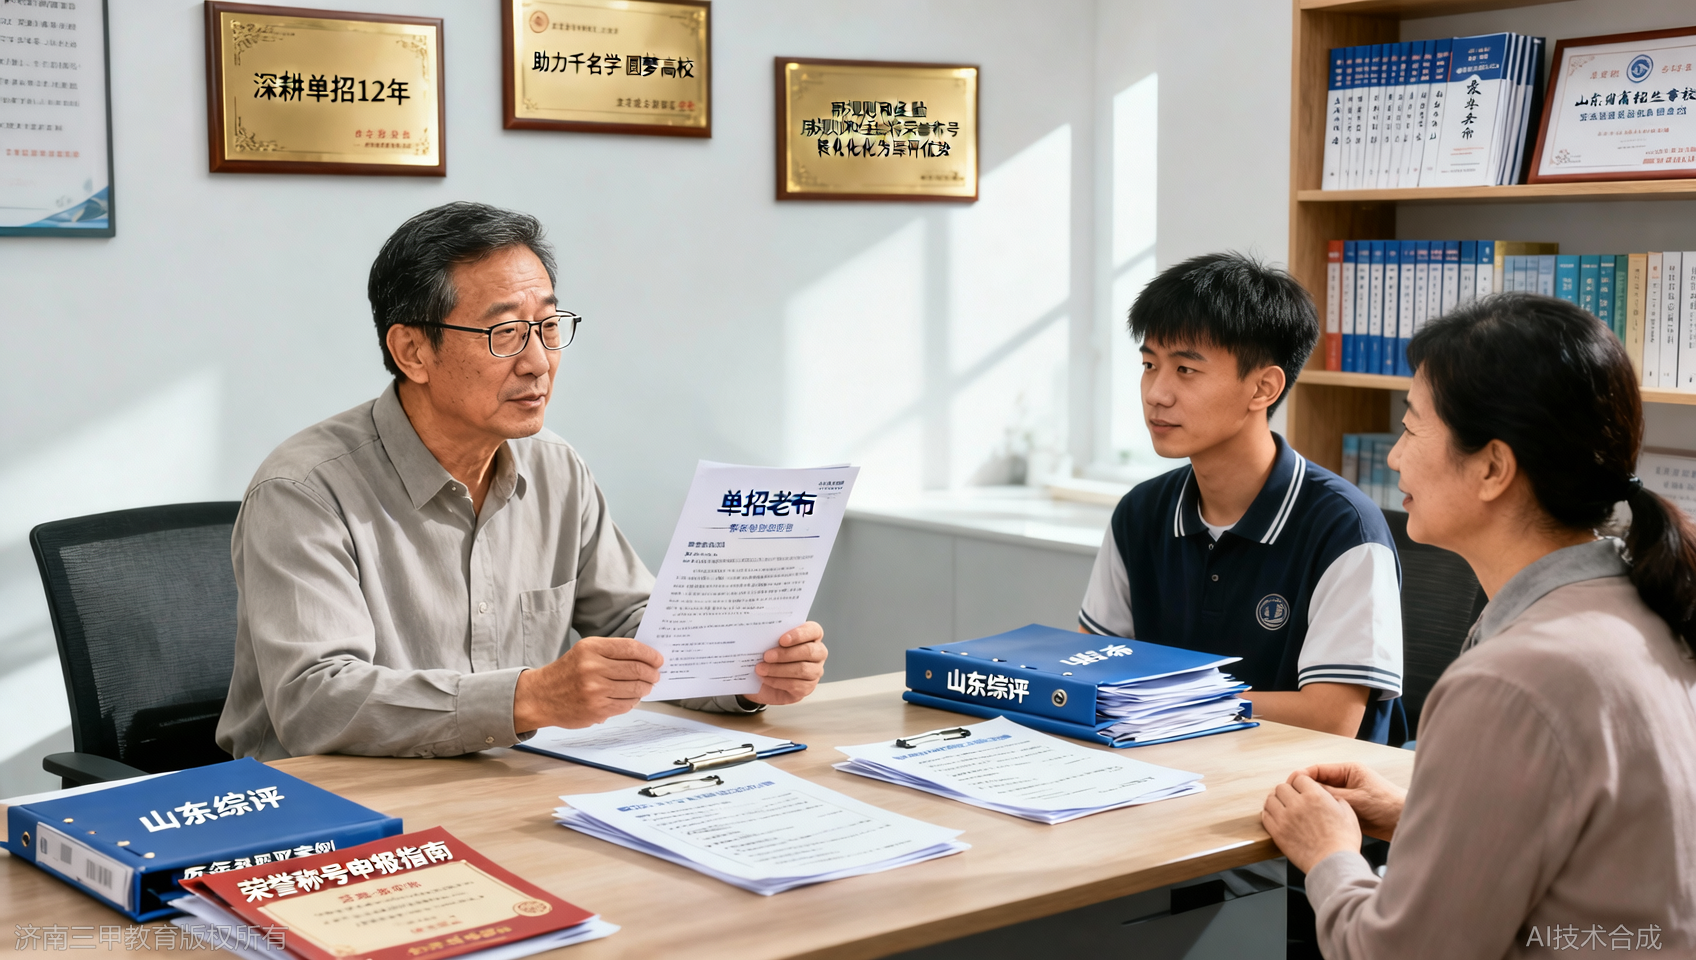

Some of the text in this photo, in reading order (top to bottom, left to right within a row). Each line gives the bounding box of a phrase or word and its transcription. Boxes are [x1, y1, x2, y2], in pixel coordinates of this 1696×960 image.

[253, 71, 411, 106] 深耕单招12年
[947, 668, 1030, 704] 山东综评
[138, 785, 285, 833] 山东综评
[237, 841, 454, 903] 荣誉称号申报指南
